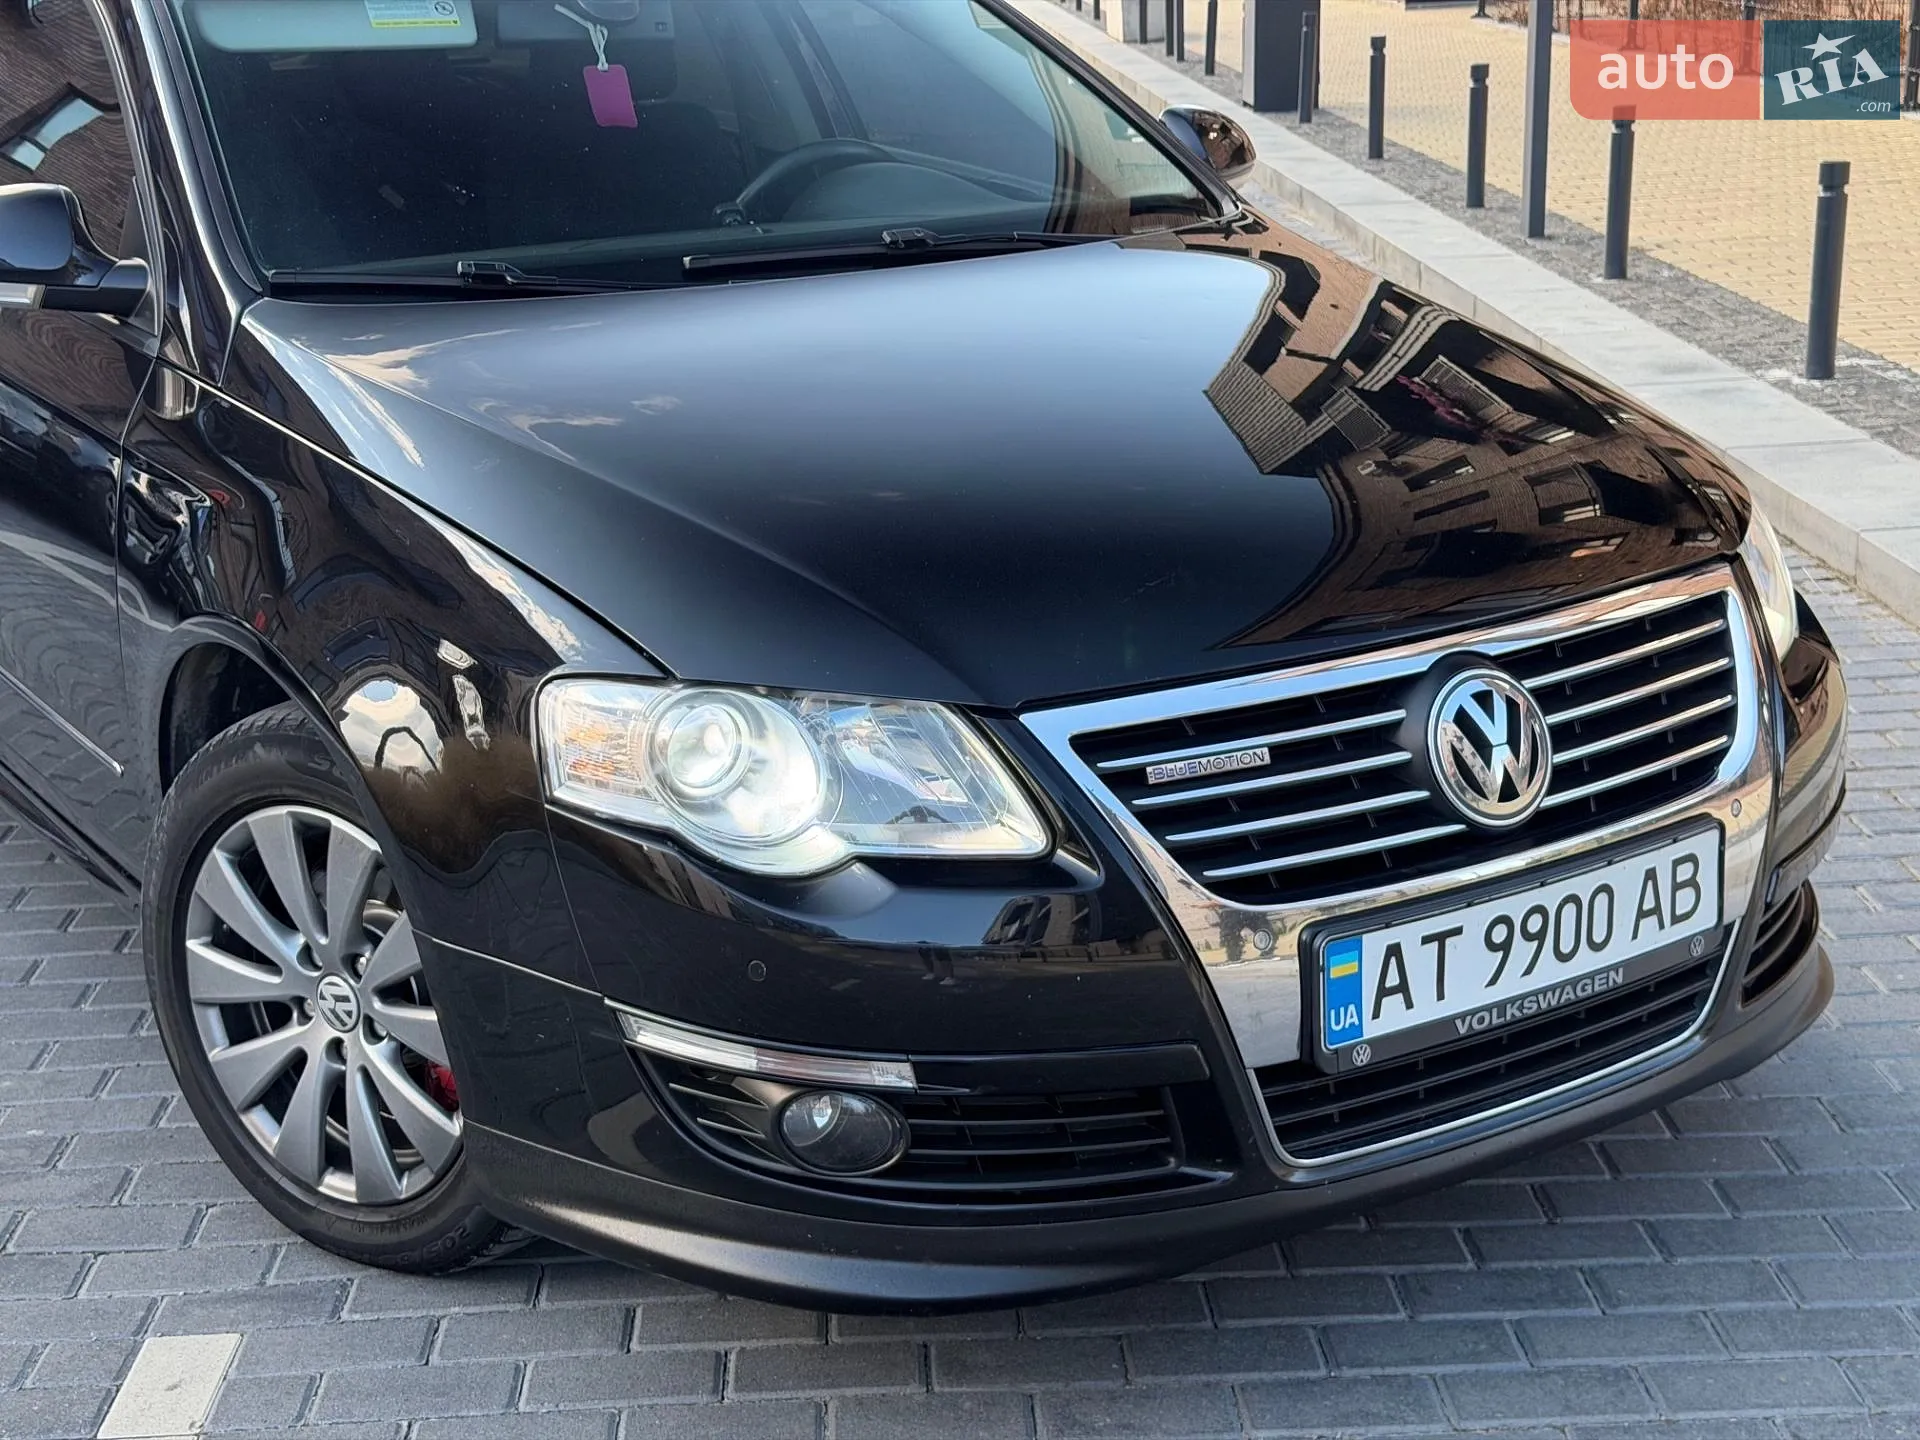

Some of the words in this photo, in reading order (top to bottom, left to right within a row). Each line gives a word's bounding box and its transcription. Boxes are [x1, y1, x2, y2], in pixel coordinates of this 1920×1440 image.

[1152, 750, 1266, 780] BLUEMOTION
[1371, 924, 1464, 1021] AT
[1484, 882, 1615, 989] 9900
[1630, 852, 1702, 943] AB
[1330, 1003, 1360, 1031] UA
[1454, 967, 1624, 1034] VOLKSWAGEN
